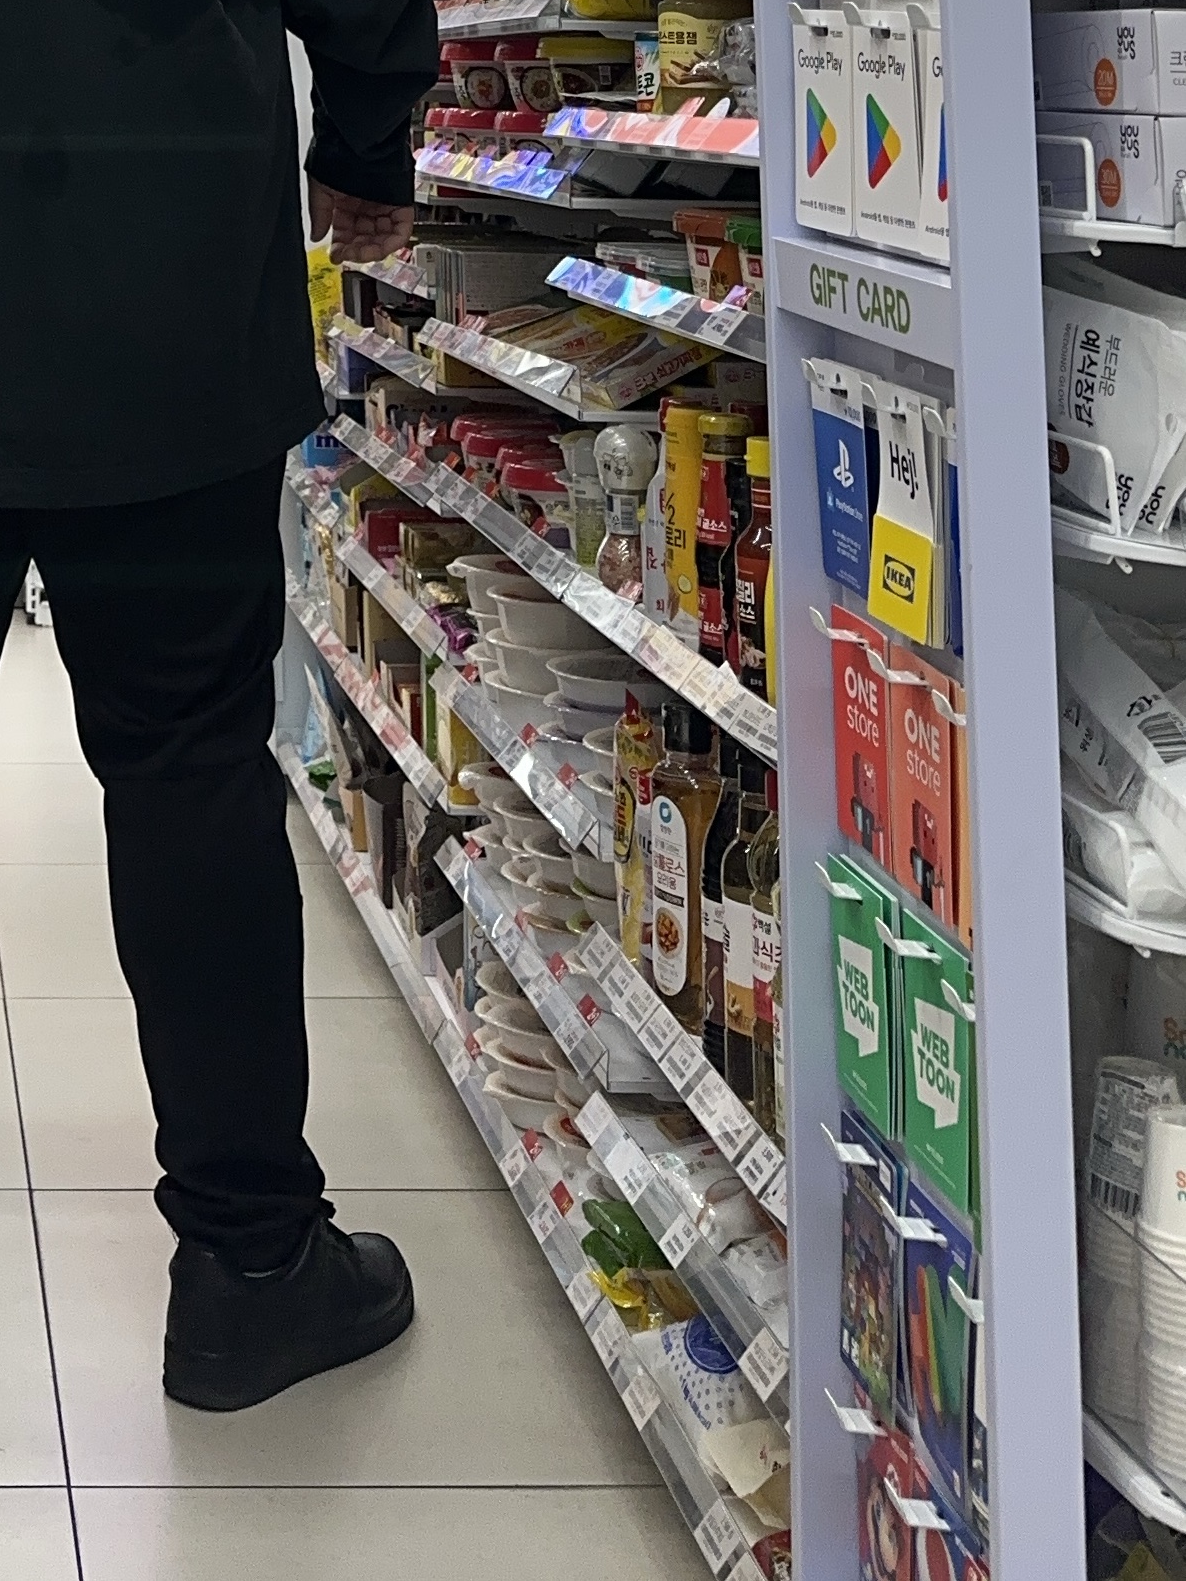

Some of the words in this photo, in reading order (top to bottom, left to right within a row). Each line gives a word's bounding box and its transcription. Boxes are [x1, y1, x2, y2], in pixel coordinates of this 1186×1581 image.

[798, 48, 825, 75] Google
[826, 52, 843, 77] Play
[857, 51, 886, 79] Google
[887, 54, 906, 82] Play
[809, 262, 849, 315] GIFT
[856, 276, 911, 335] CARD
[1074, 328, 1101, 429] 예식장갑
[1099, 334, 1122, 397] 부드러운
[888, 439, 920, 500] Hej!
[885, 563, 913, 593] IKEA
[843, 665, 879, 716] ONE
[846, 706, 880, 749] store
[903, 708, 942, 763] ONE
[906, 748, 942, 797] store
[843, 956, 870, 1001] WEB
[842, 988, 876, 1034] TOON
[920, 1021, 951, 1070] WEB
[918, 1052, 956, 1105] TOON
